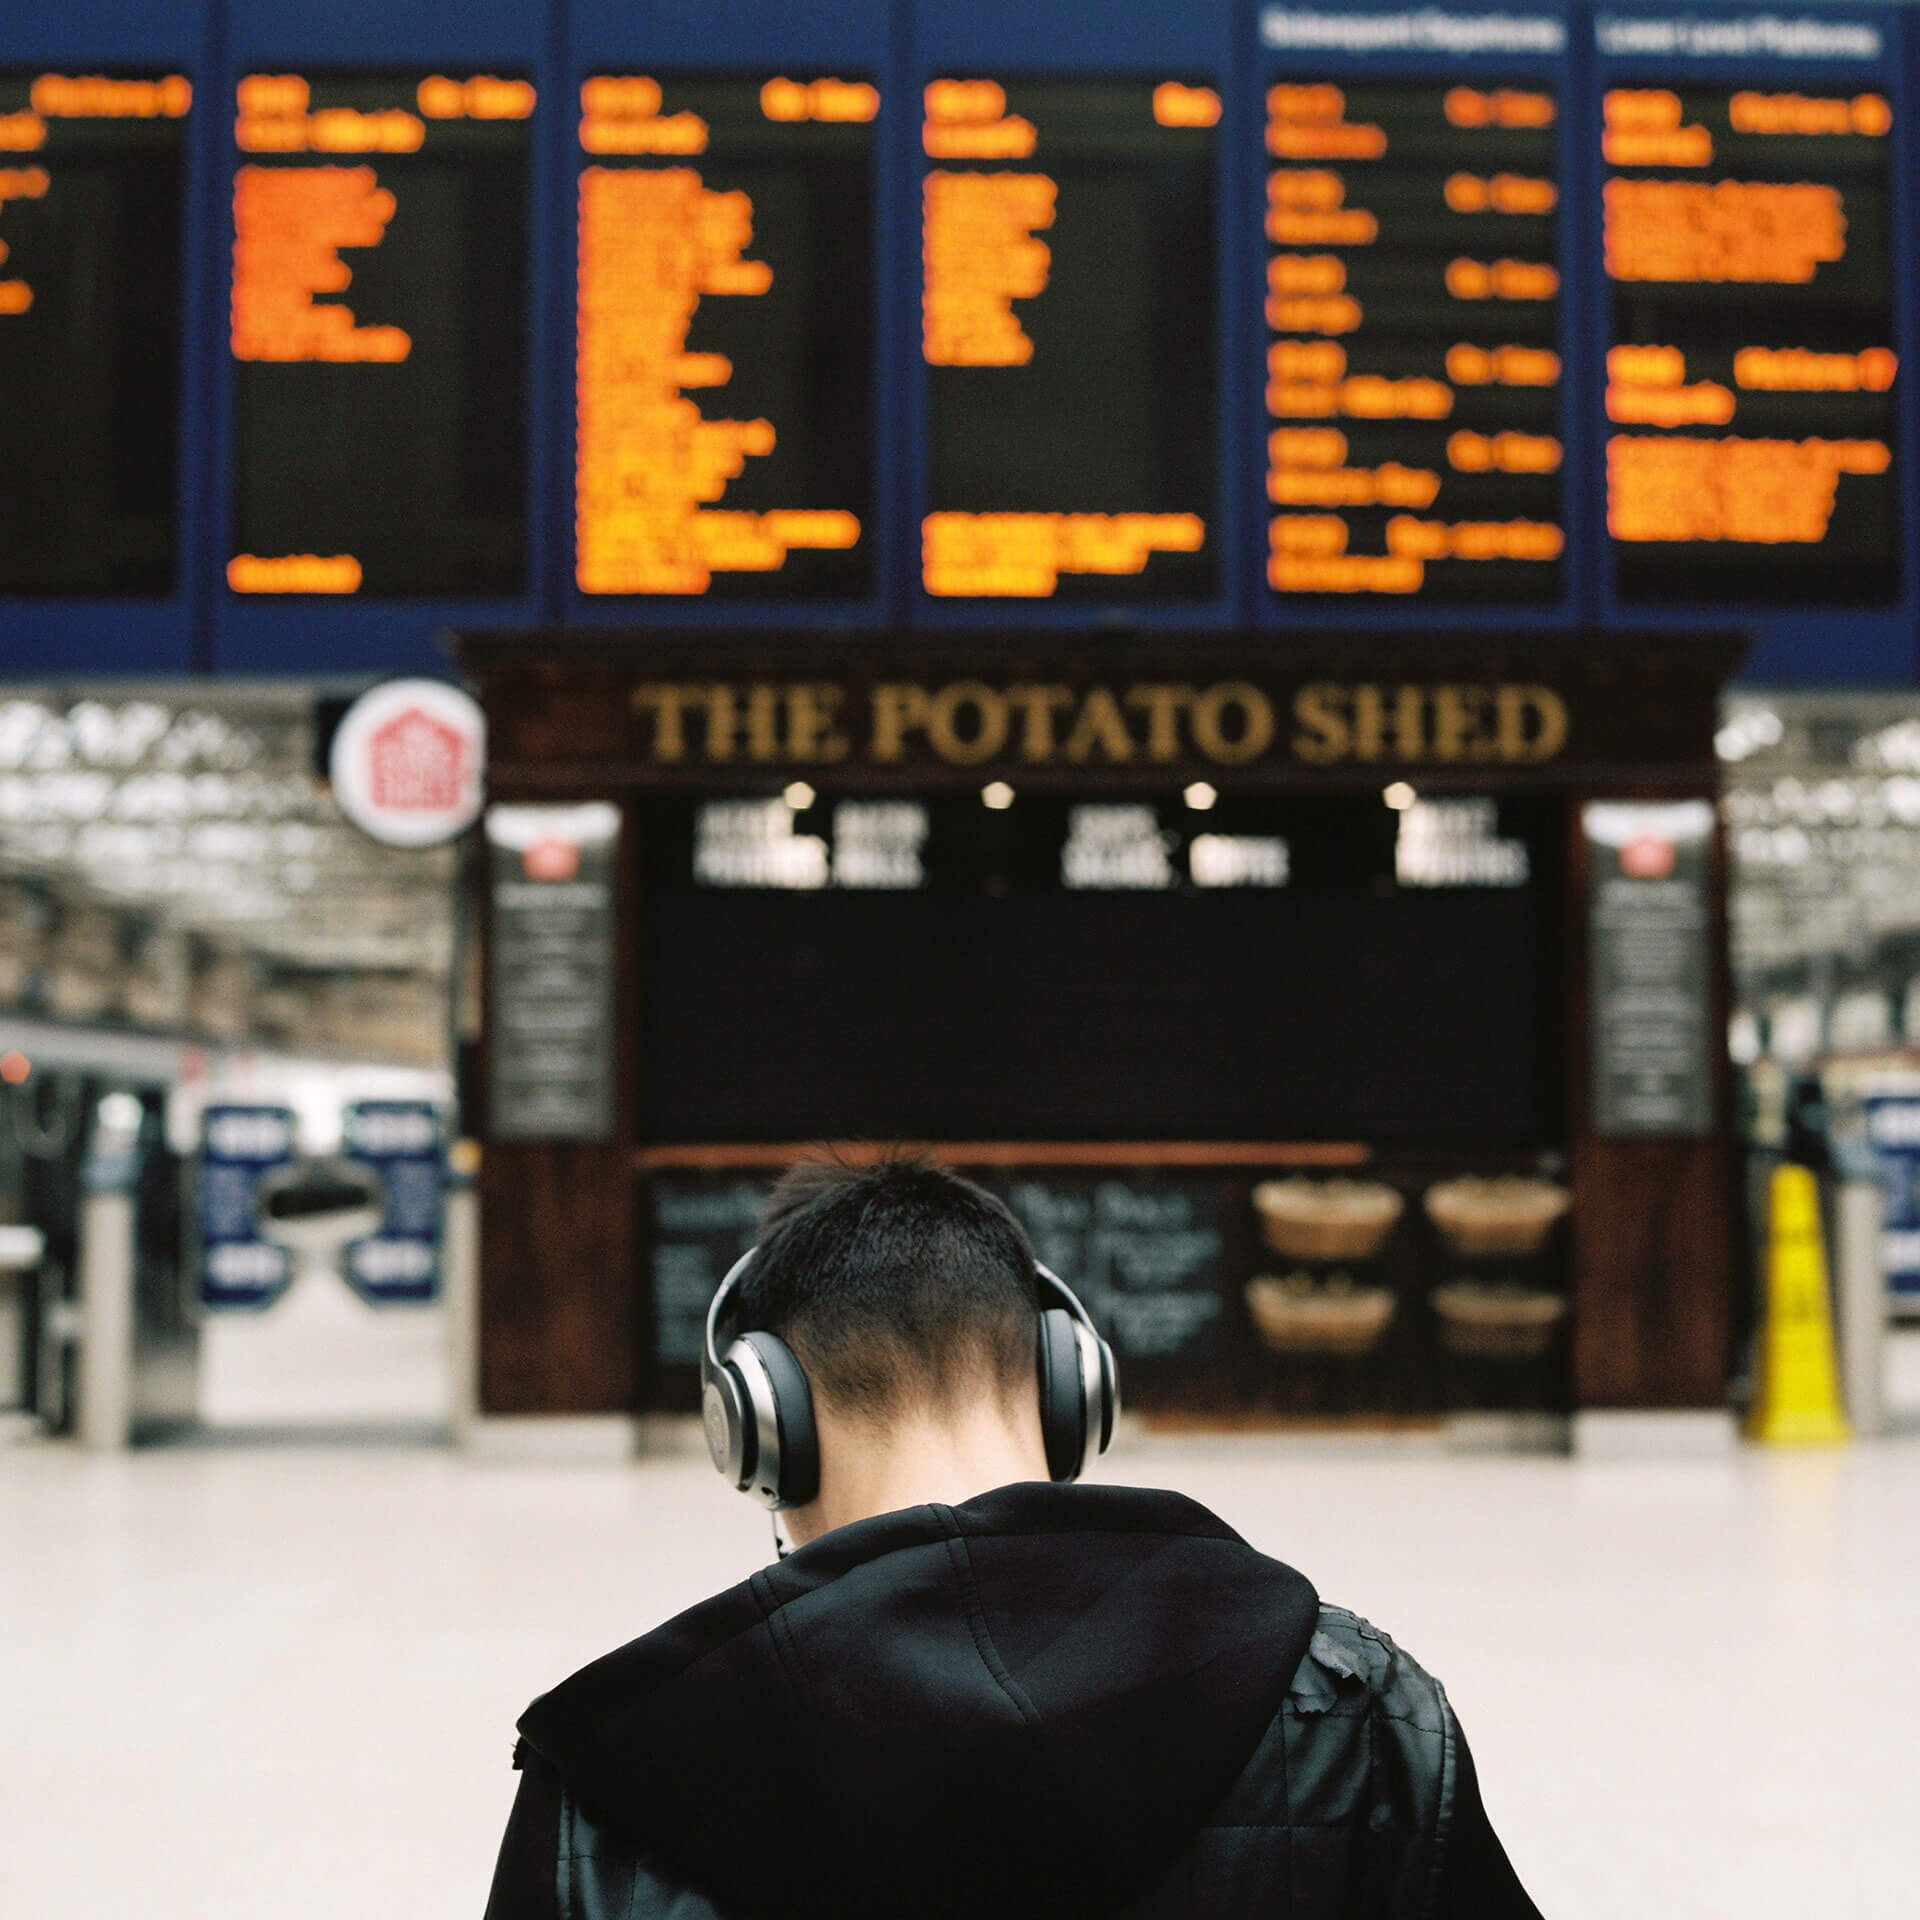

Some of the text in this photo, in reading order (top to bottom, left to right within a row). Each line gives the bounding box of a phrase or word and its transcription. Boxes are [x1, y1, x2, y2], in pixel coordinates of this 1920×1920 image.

[636, 681, 1569, 765] THE POTATO SHED
